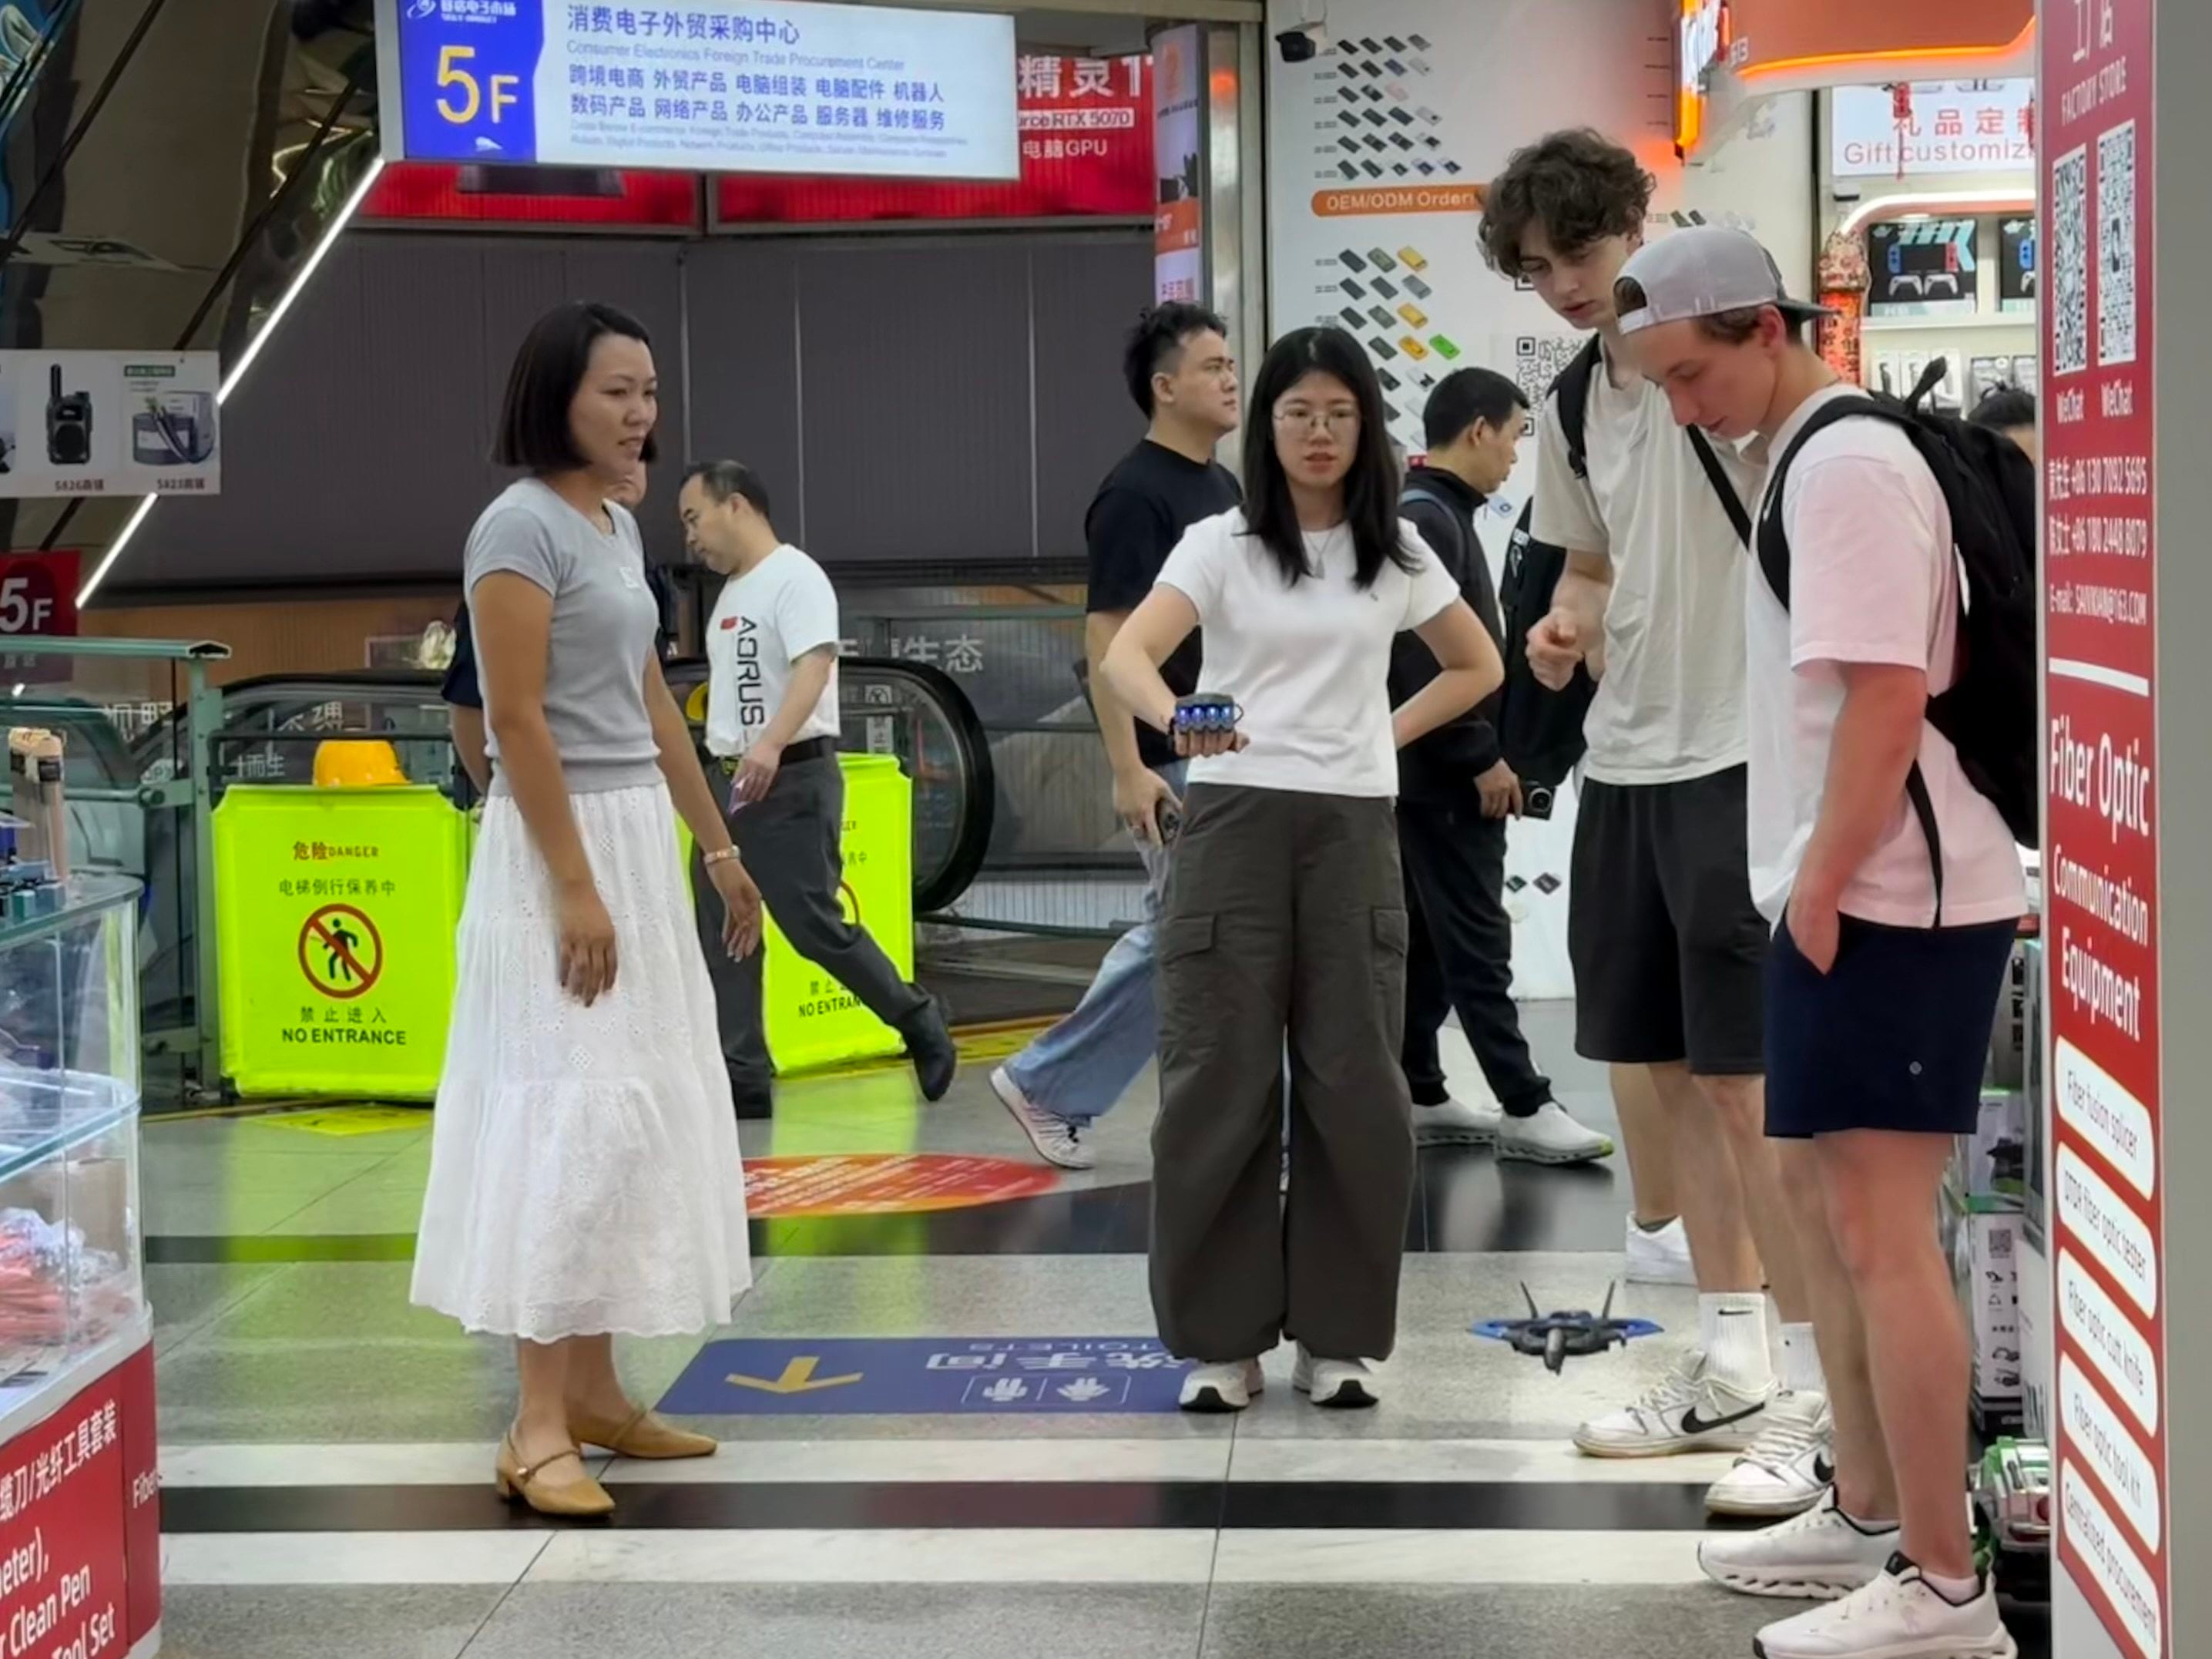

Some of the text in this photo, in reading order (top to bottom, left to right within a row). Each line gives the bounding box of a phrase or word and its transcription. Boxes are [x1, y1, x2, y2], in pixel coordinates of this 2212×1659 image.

[568, 5, 800, 45] 消费电子外贸采购中心
[567, 40, 904, 70] Consumer Electronics Foreign Trade Procurement Center
[436, 45, 519, 123] 5F
[569, 64, 944, 102] 跨境电商 外贸产品 电脑组装 电脑配件 机器人
[571, 93, 945, 130] 数码产品 网络产品 办公产品 服务器 维修服务
[1052, 113, 1085, 126] RTX
[1090, 111, 1130, 125] 5070
[1844, 142, 1893, 164] Gift
[1327, 192, 1413, 210] OEM/ODM
[2102, 379, 2133, 418] WeChat
[0, 577, 53, 633] 5F
[737, 616, 765, 725] AORUS
[2050, 715, 2150, 843] Fiber Optic
[2053, 844, 2148, 947] Communication
[2062, 925, 2140, 1041] Equipment
[300, 1006, 387, 1023] 禁止进入
[799, 1002, 814, 1017] NO
[282, 1028, 407, 1046] NO ENTRANCE
[0, 1526, 49, 1600] eter),
[10, 1593, 57, 1657] Clean
[60, 1564, 91, 1617] Pen
[90, 1601, 115, 1657] Set
